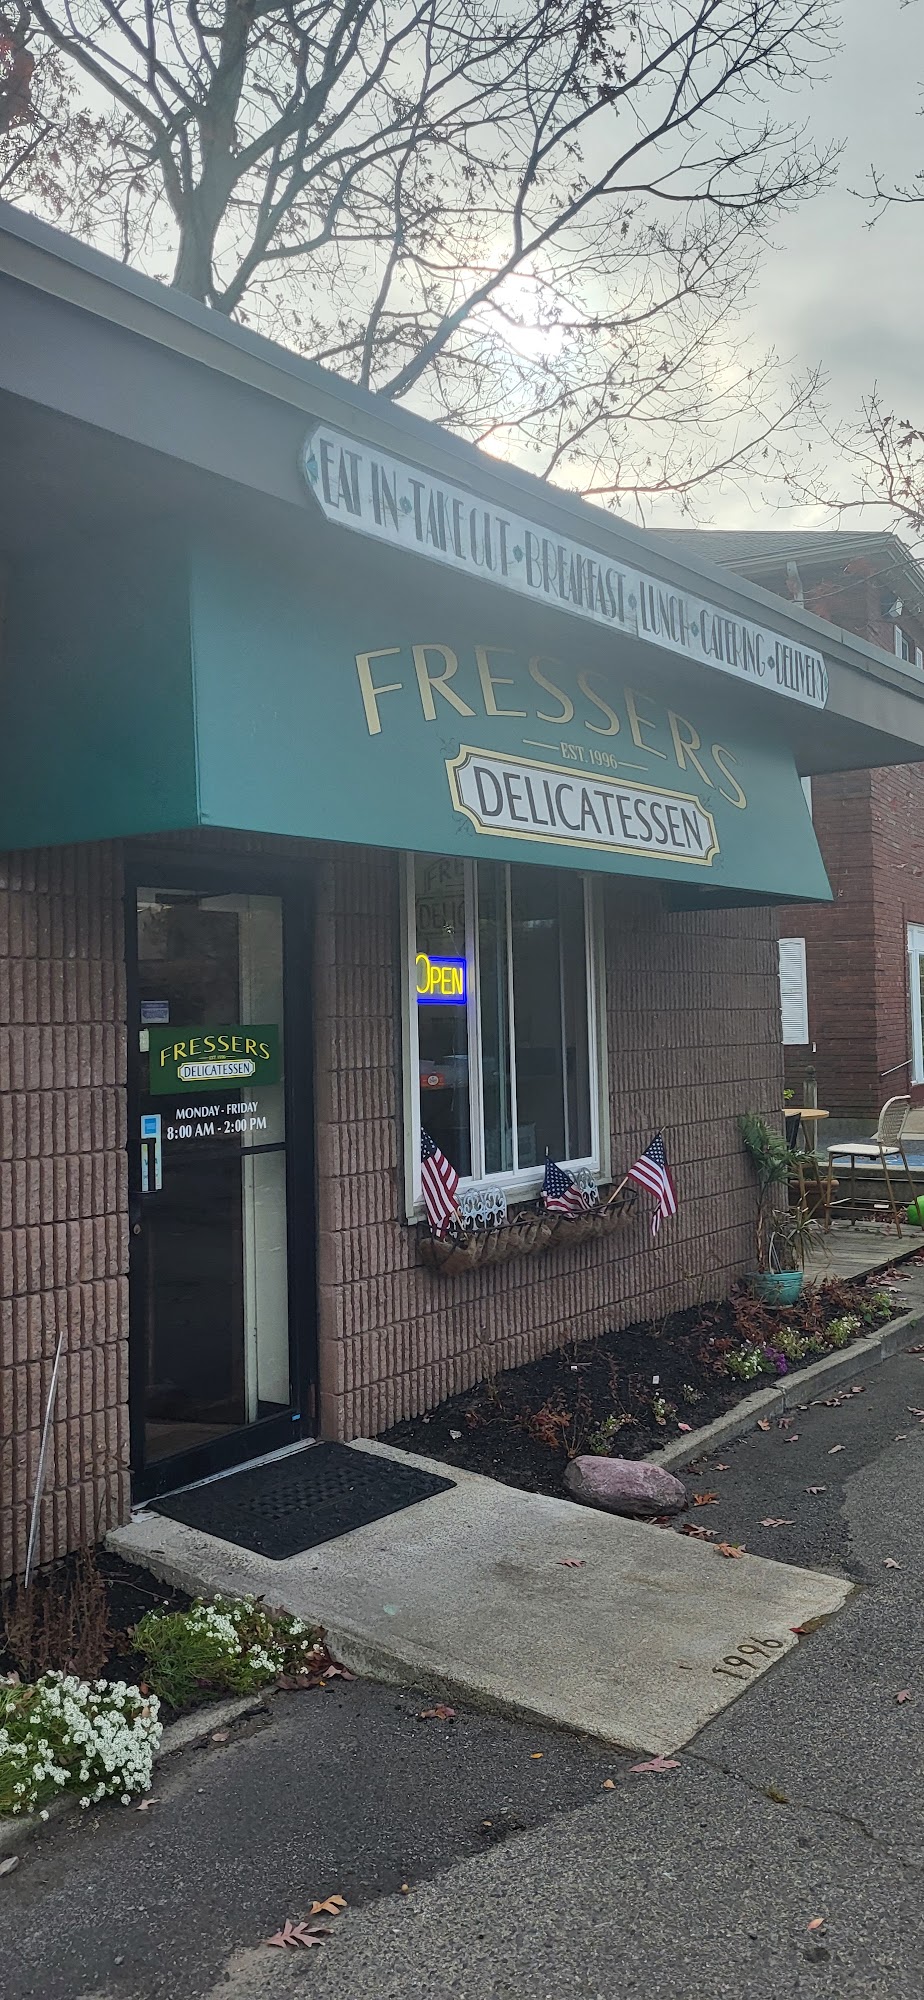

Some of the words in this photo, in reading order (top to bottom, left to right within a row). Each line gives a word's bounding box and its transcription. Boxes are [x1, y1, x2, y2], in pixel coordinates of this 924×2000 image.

[319, 438, 363, 517] EAT
[370, 461, 400, 533] IN
[407, 477, 467, 561] TAKE
[469, 507, 511, 577] OUT
[524, 530, 627, 623] BREAKFAST
[639, 581, 691, 648] LUNCH
[700, 609, 766, 677] CATERING
[775, 640, 827, 703] DELIVERY
[355, 643, 748, 810] FRESSERS
[560, 741, 588, 763] EST.
[589, 749, 618, 770] 1996
[472, 765, 705, 851] DELICATESSEN
[415, 953, 464, 995] OPEN
[160, 1035, 270, 1067] FRESSERS
[184, 1062, 250, 1078] DELICATESSEN
[167, 1124, 193, 1141] 8:00
[195, 1121, 215, 1137] AM
[223, 1118, 247, 1134] 2:00
[249, 1116, 267, 1131] PM
[175, 1105, 220, 1120] MONDAY
[226, 1101, 258, 1115] FRIDAY
[711, 1636, 784, 1680] 1996
